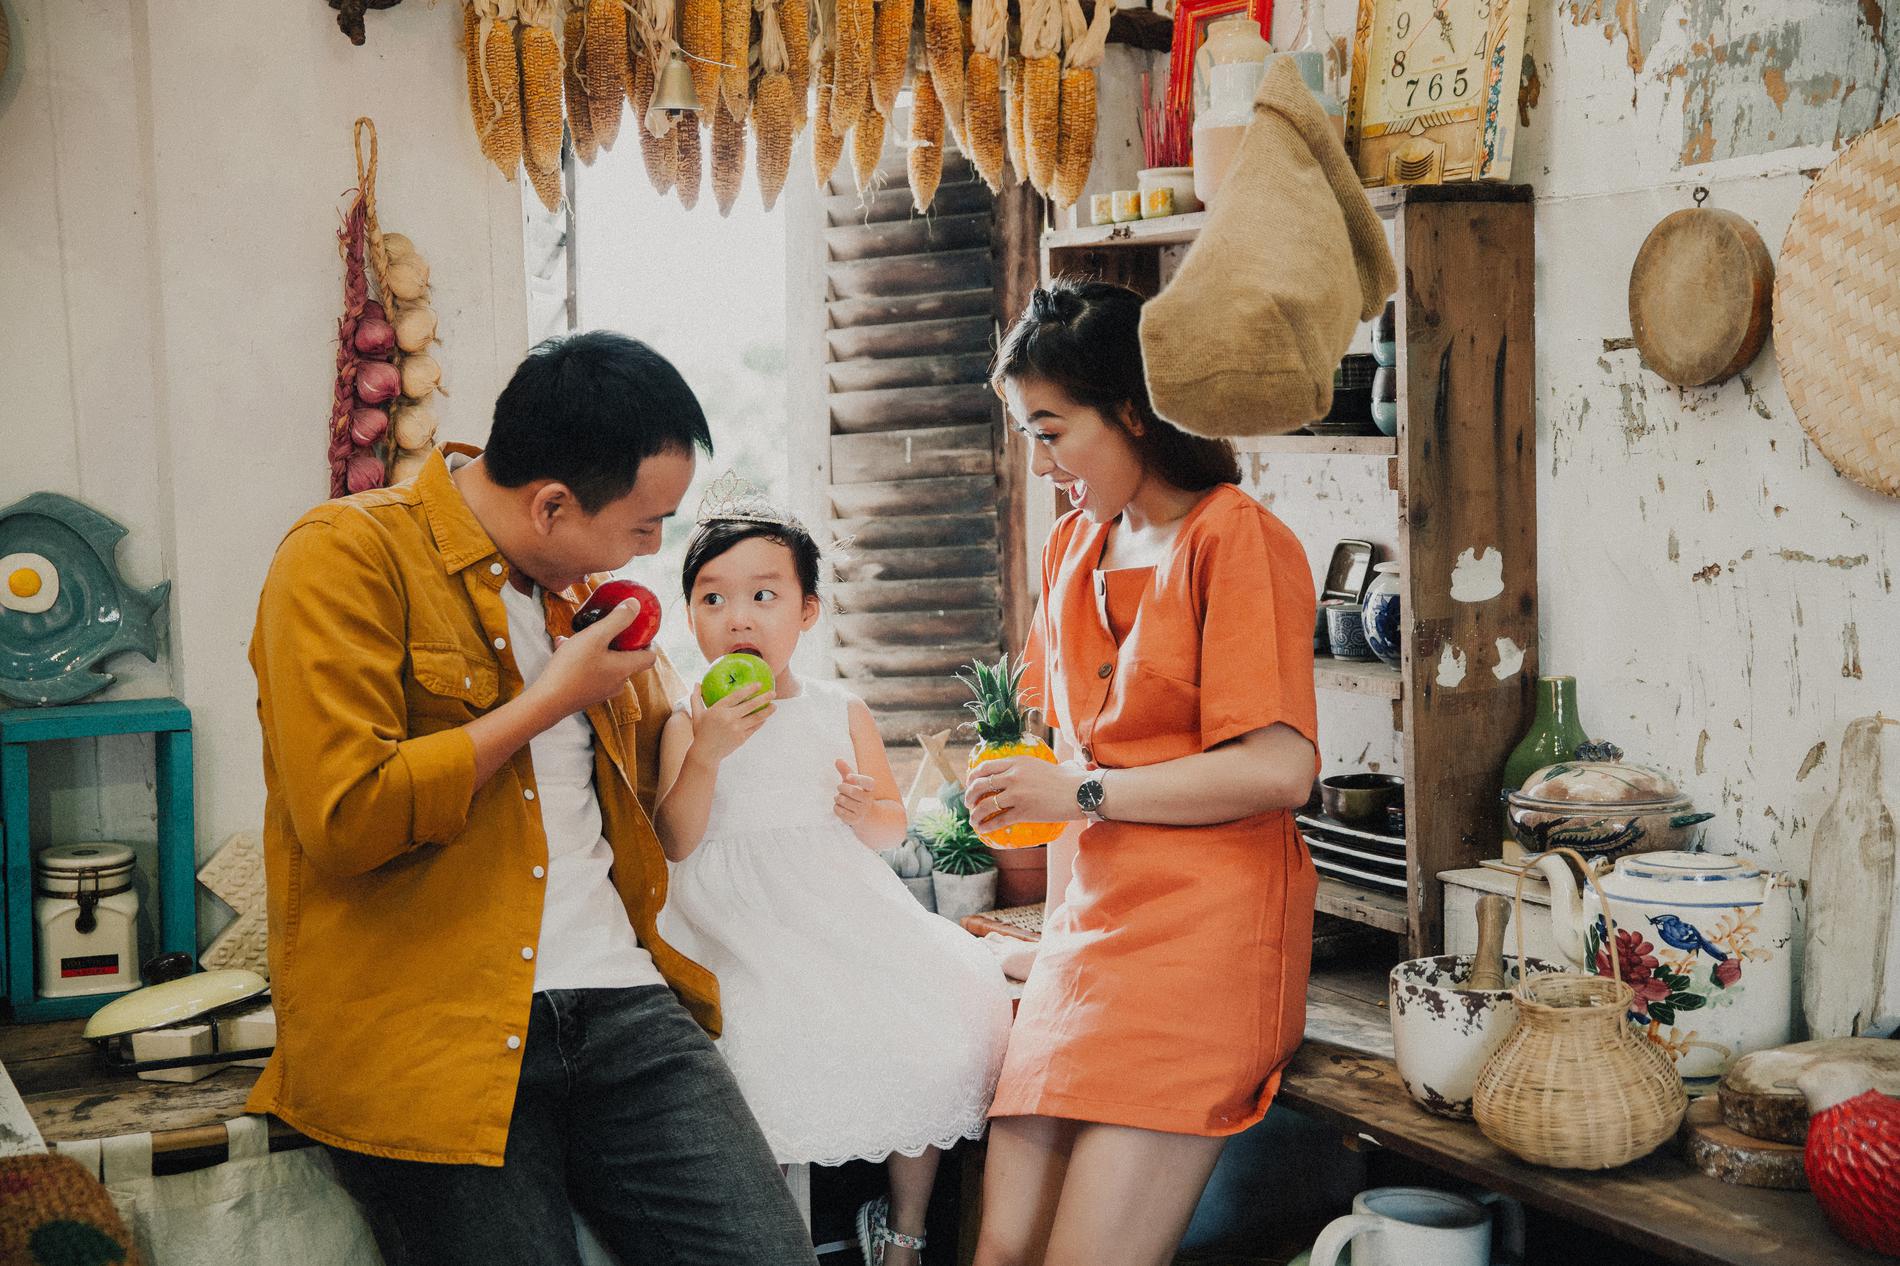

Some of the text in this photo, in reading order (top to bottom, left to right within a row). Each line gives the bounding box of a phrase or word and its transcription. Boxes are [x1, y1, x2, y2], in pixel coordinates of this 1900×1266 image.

[1397, 12, 1411, 39] 9
[1474, 31, 1488, 60] 4
[1391, 50, 1406, 78] 8
[1406, 67, 1468, 107] 7 6 5
